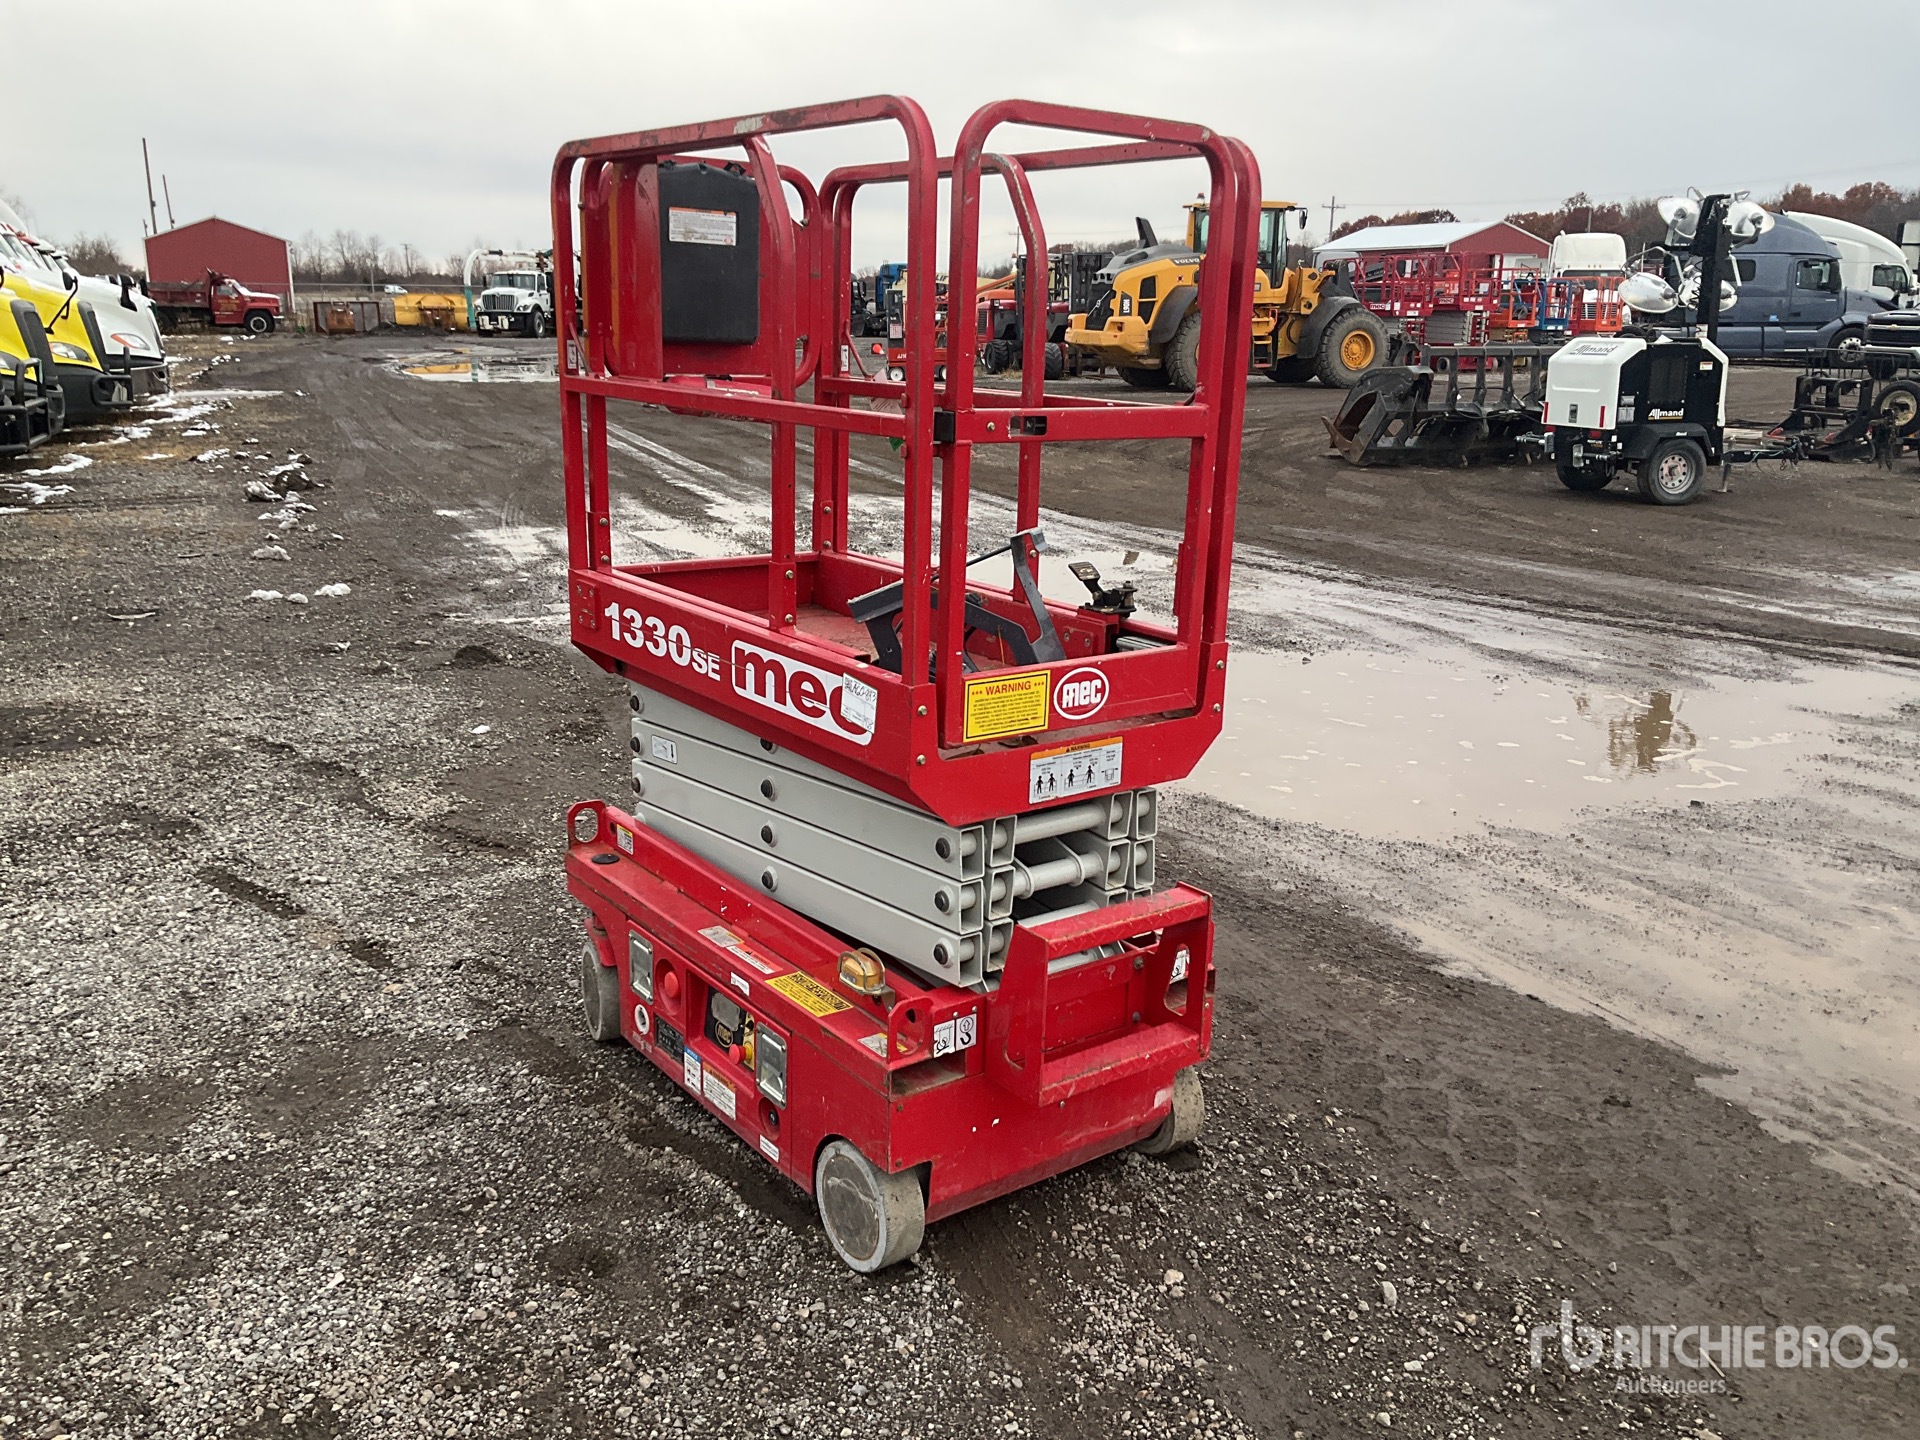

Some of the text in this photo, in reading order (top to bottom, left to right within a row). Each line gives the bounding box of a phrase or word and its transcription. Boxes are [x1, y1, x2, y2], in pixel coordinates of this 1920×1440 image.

[1174, 257, 1200, 265] VOLVO
[1573, 343, 1619, 355] Allmand
[1648, 407, 1684, 420] Allmand
[985, 681, 1031, 695] WARNING
